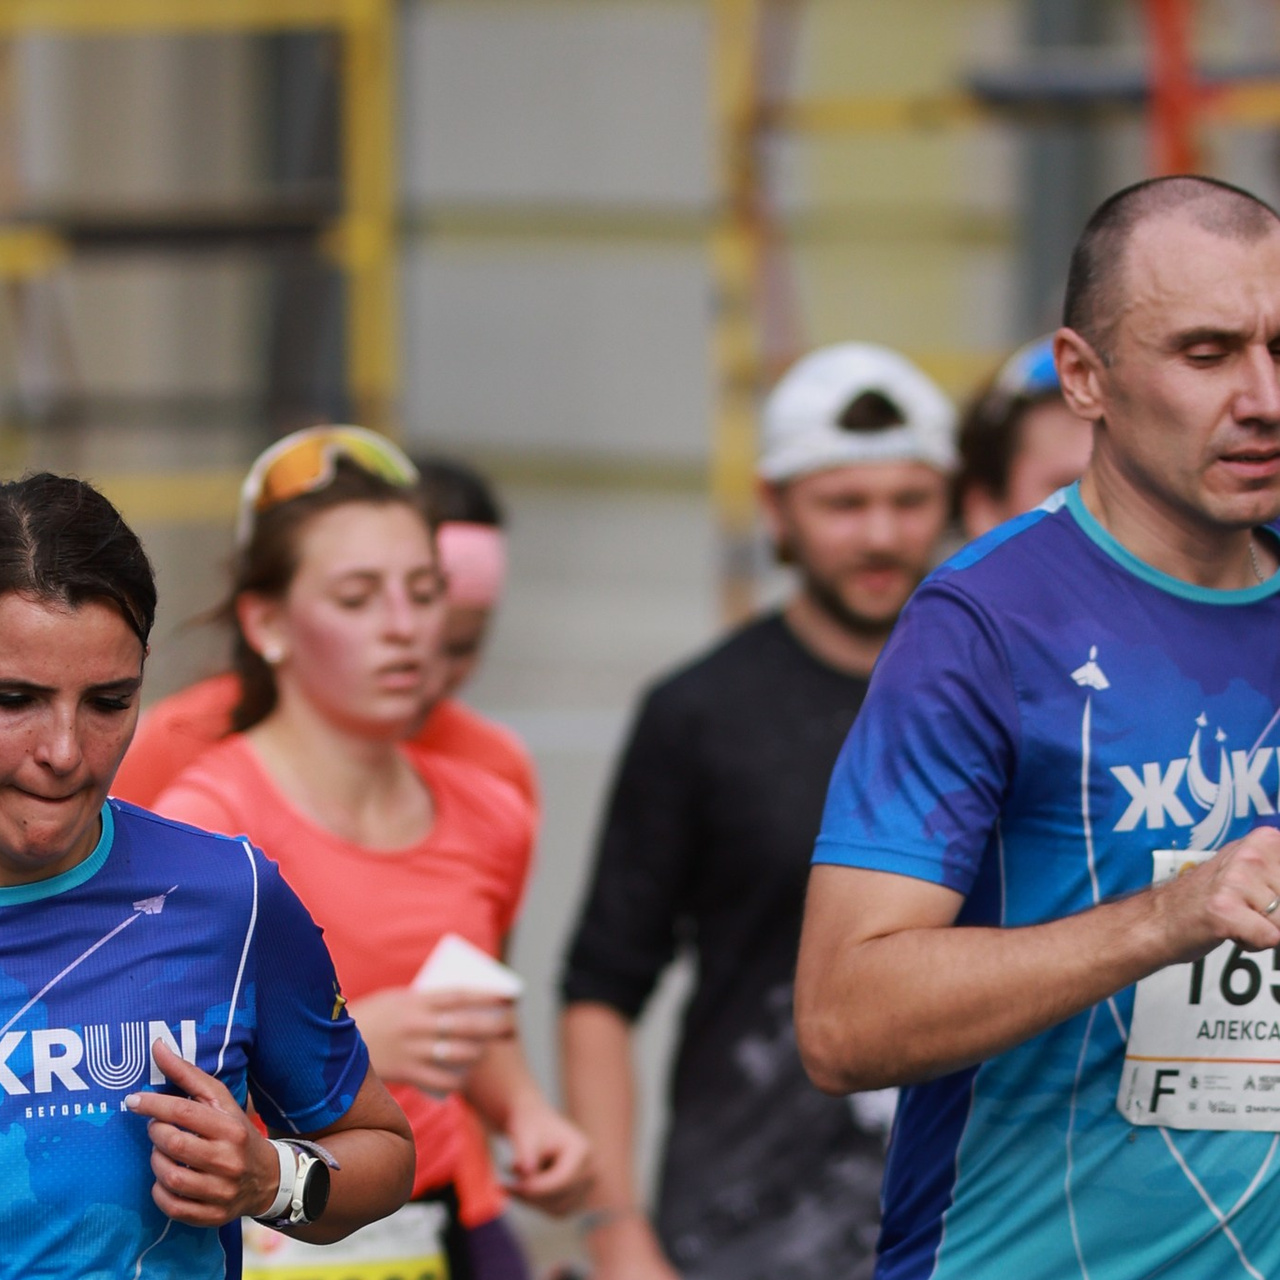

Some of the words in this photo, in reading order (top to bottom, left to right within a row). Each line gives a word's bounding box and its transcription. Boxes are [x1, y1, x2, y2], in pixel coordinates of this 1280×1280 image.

[1110, 728, 1280, 850] ЖУК
[1189, 941, 1280, 1006] 16
[25, 1103, 108, 1119] БЕГОВАЯ
[1149, 1069, 1180, 1113] F
